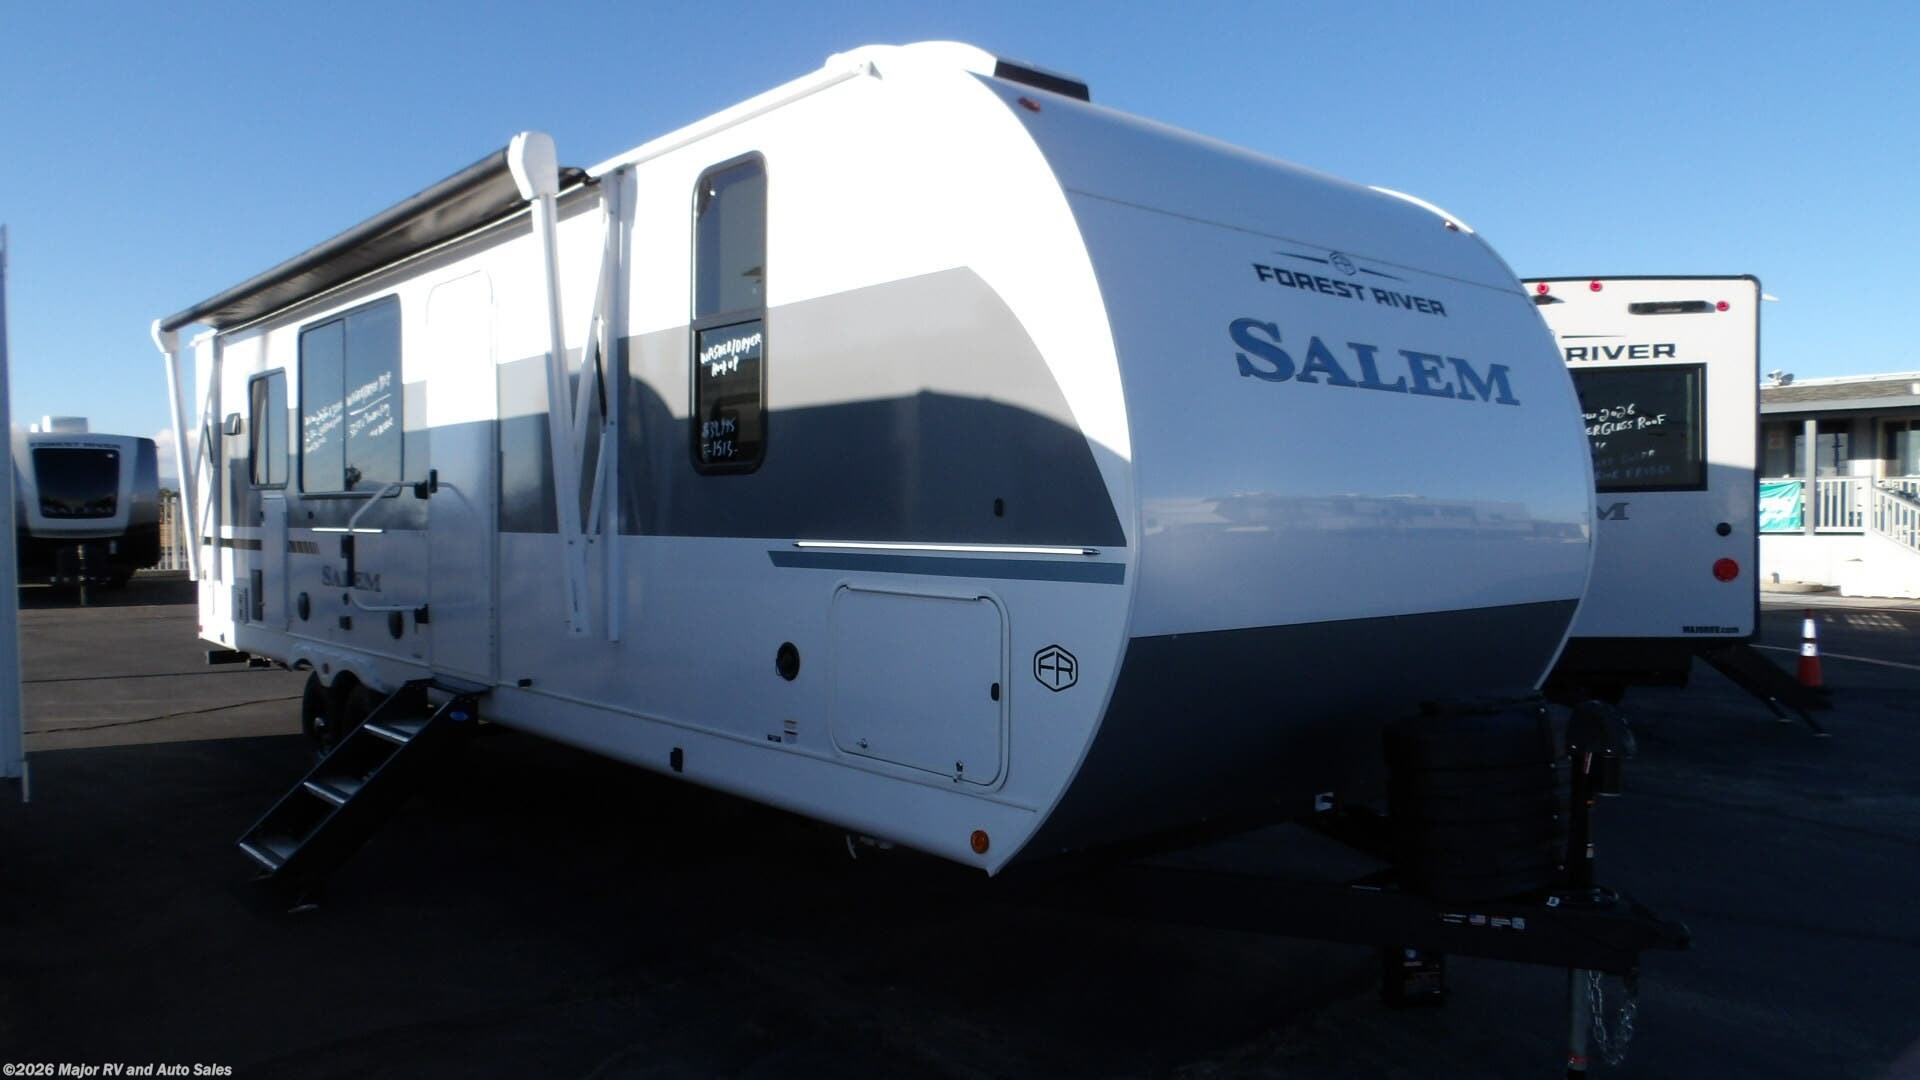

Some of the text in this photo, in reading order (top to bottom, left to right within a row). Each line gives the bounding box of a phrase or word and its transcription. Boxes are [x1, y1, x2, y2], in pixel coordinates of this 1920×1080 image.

[1251, 263, 1365, 302] FOREST
[1370, 288, 1448, 317] RIVER
[1229, 316, 1521, 406] SALEM
[1564, 343, 1676, 362] RIVER
[1598, 403, 1636, 422] 2026
